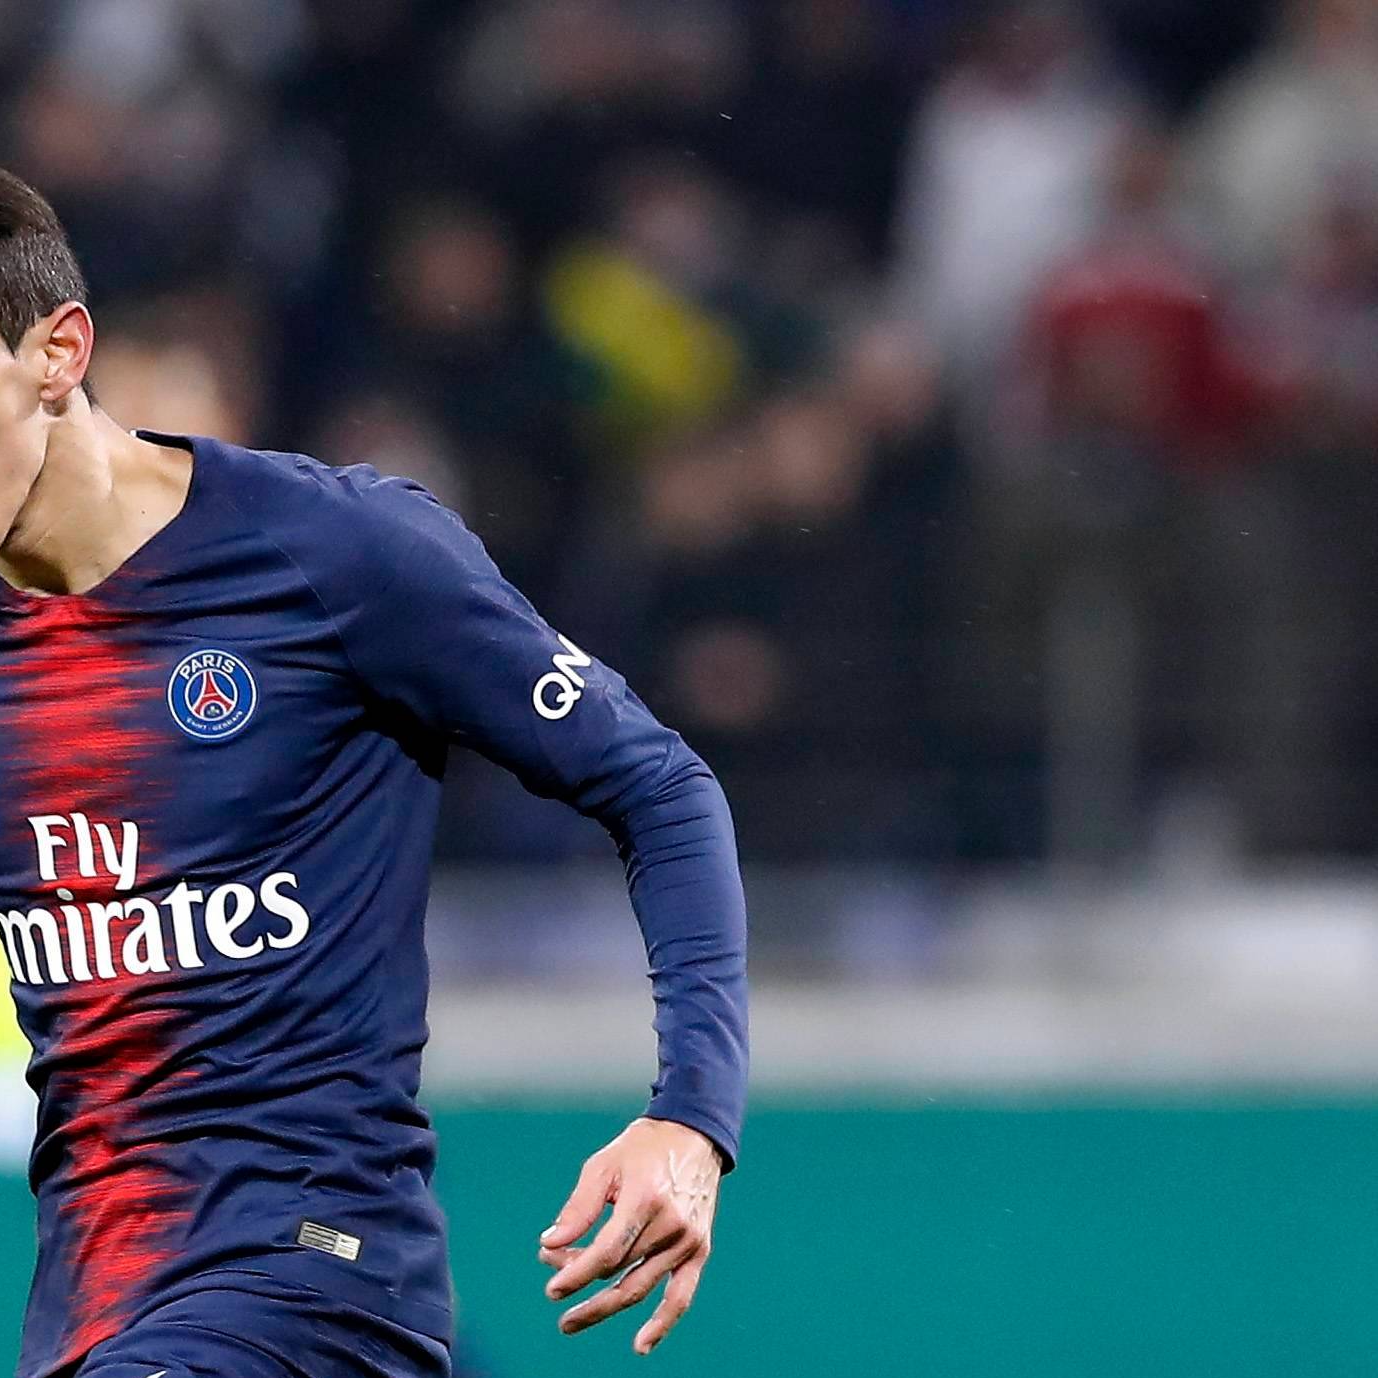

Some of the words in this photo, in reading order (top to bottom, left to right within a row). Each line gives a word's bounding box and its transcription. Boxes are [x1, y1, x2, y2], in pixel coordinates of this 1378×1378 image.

[179, 654, 236, 681] PARIS
[532, 632, 592, 720] QN
[27, 811, 140, 891] Fly
